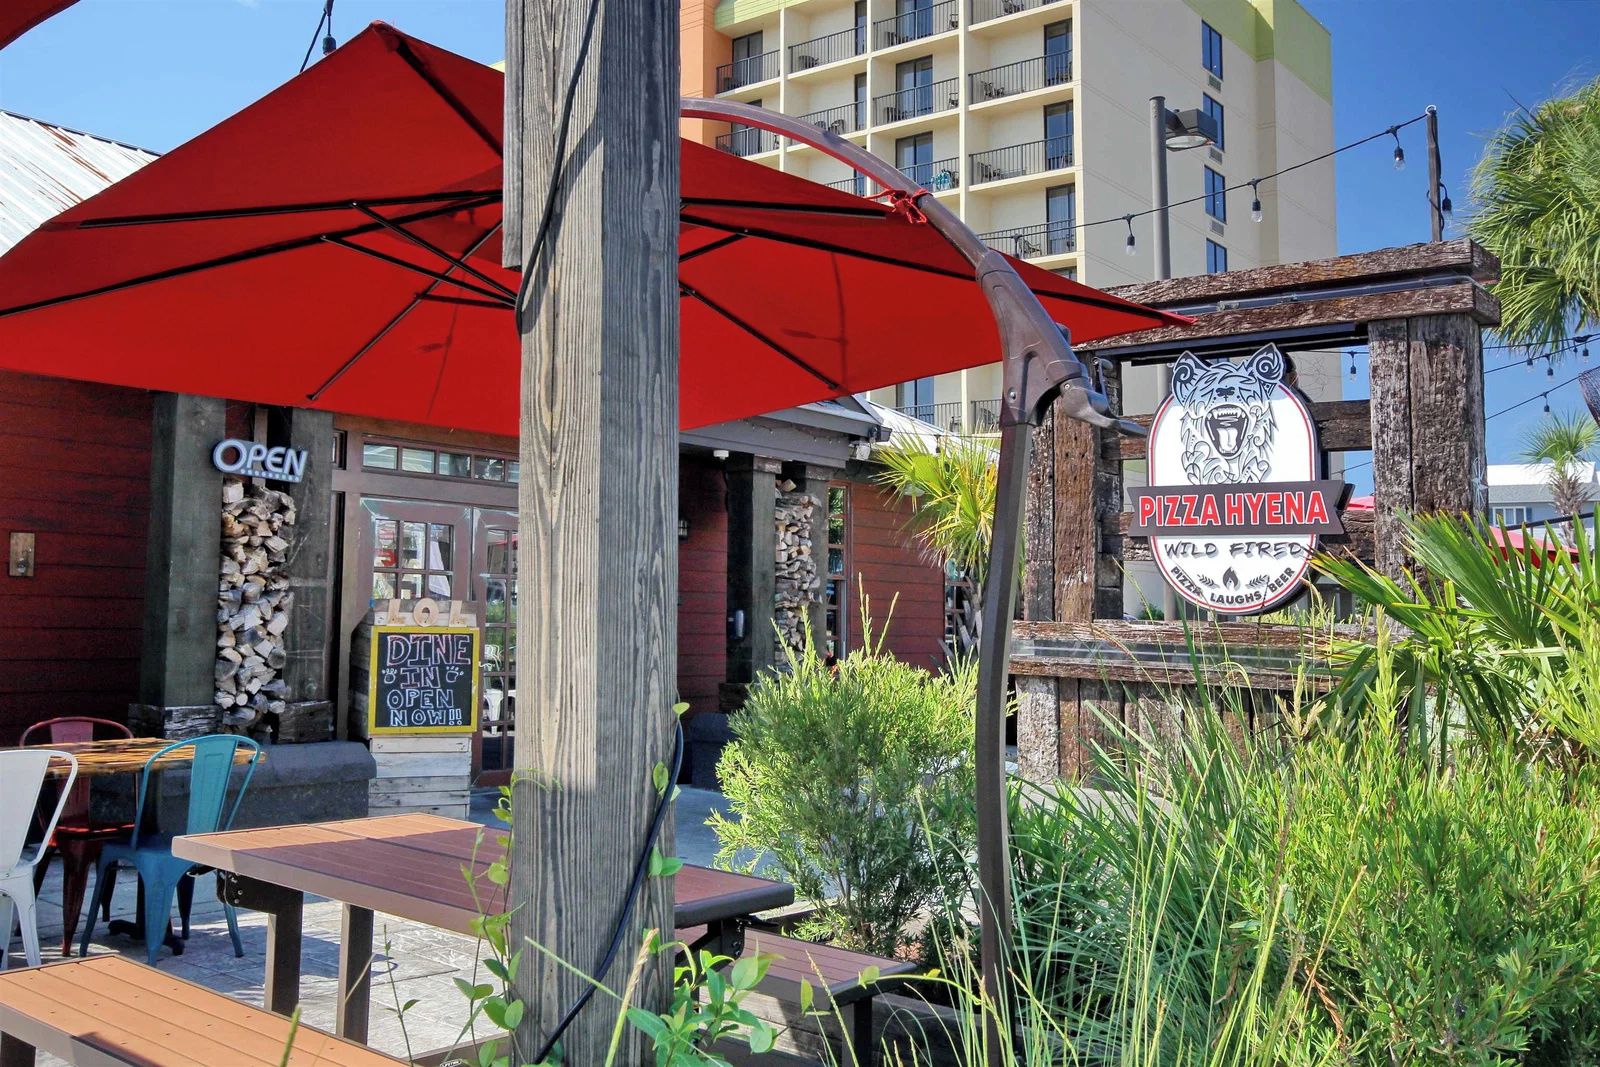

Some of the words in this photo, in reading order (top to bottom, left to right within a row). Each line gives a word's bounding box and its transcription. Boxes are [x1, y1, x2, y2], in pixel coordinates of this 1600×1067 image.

[213, 439, 308, 480] OPEN
[1139, 494, 1221, 527] PIZZA
[1225, 491, 1329, 526] HYENA
[1164, 540, 1218, 558] WILD
[1229, 541, 1302, 558] FIRED
[1170, 566, 1203, 597] PIZZA
[1210, 591, 1263, 605] LAUGHS
[1268, 567, 1295, 594] BEER
[386, 598, 467, 627] LOL
[387, 634, 471, 667] DINE
[400, 667, 441, 689] IN
[387, 689, 454, 709] OPEN
[390, 709, 462, 726] NOW!!
